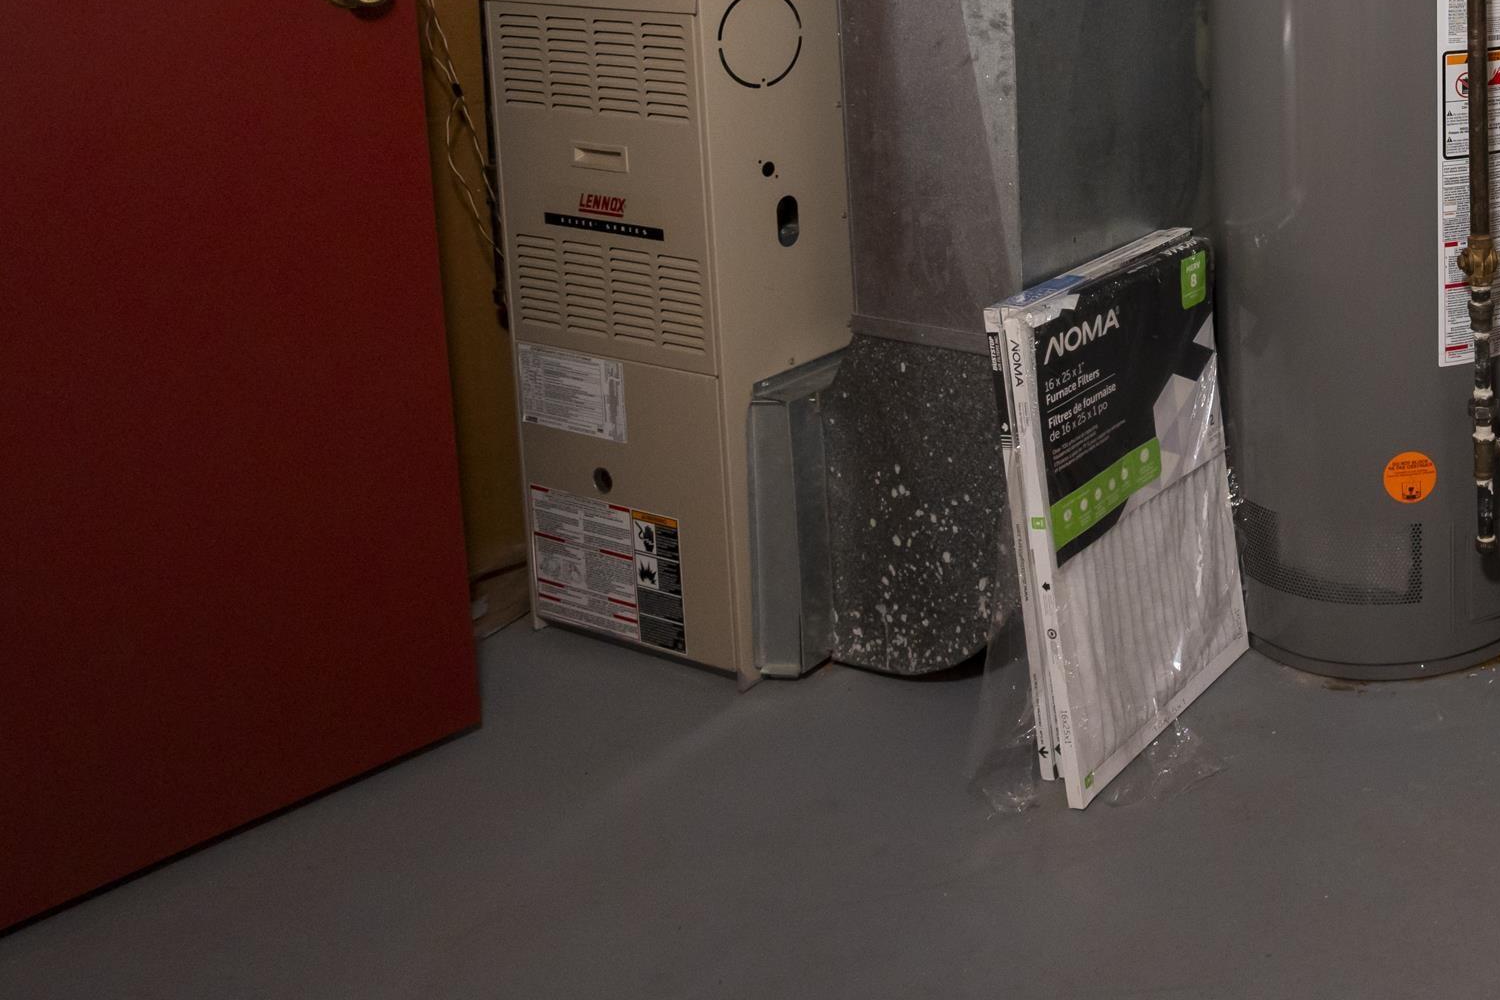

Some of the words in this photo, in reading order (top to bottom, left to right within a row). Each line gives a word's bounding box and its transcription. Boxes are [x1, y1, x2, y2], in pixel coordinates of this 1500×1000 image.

[580, 193, 626, 213] LENNOX
[1190, 273, 1197, 287] 8
[1044, 308, 1120, 365] NOMA
[1010, 340, 1024, 387] NOMA
[1045, 379, 1054, 393] 16
[1056, 378, 1061, 386] x
[1061, 370, 1071, 386] 25
[1072, 369, 1077, 377] x
[1046, 381, 1077, 406] Furnace
[1077, 368, 1100, 389] Filters
[1048, 408, 1072, 429] Filtres
[1073, 399, 1082, 412] de
[1082, 382, 1117, 409] fournaise
[1049, 427, 1061, 443] de
[1062, 422, 1071, 437] 16
[1072, 420, 1077, 430] x
[1077, 412, 1087, 428] 25
[1087, 411, 1092, 420] x
[1092, 404, 1097, 416] 1
[1097, 400, 1108, 415] po
